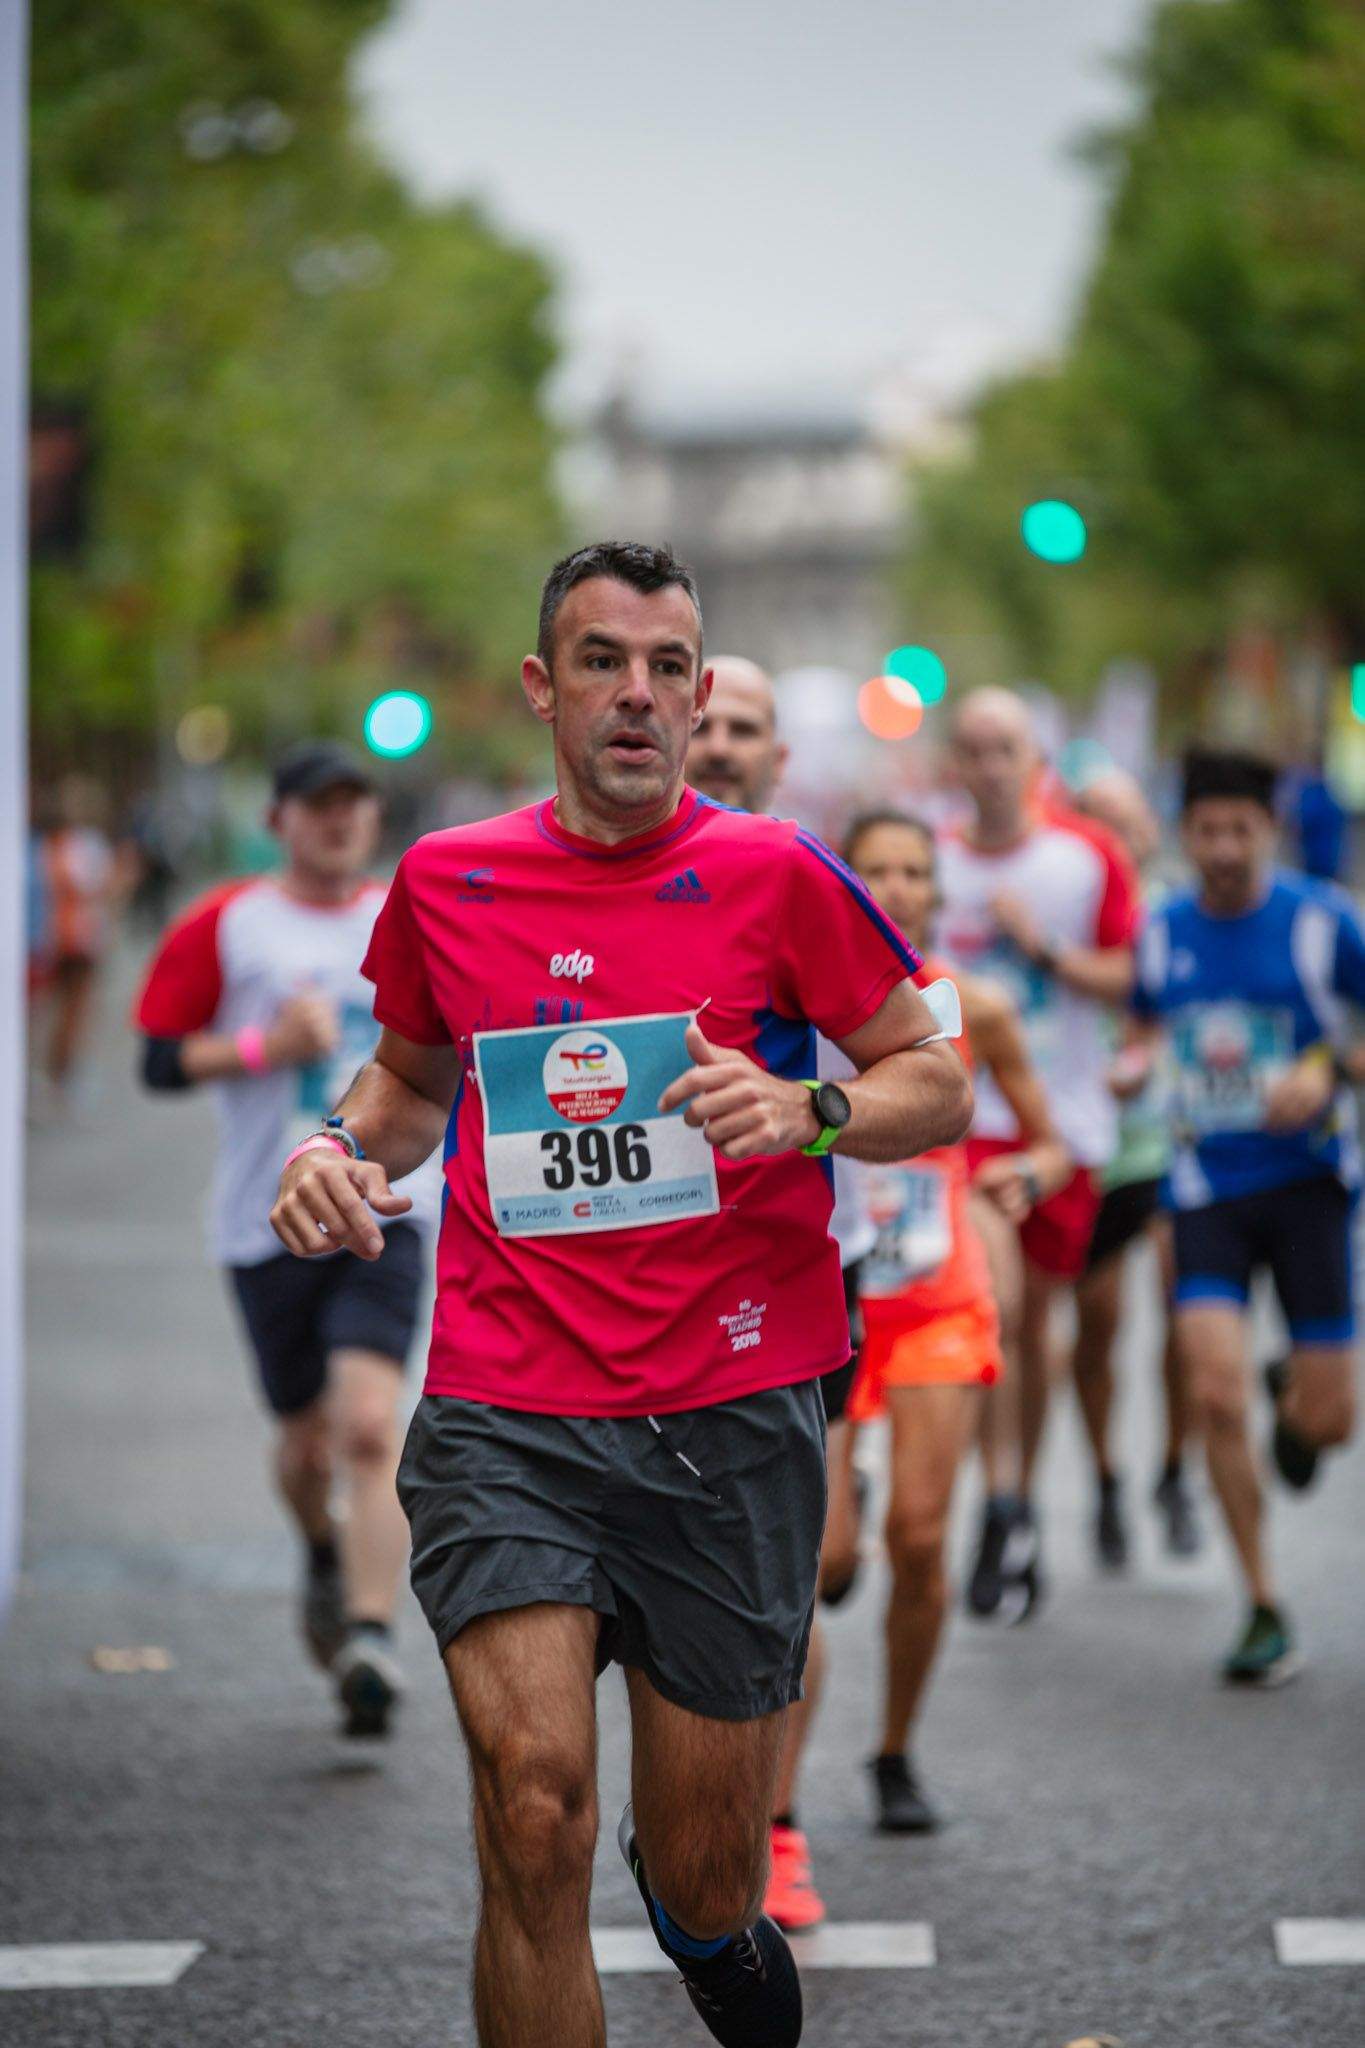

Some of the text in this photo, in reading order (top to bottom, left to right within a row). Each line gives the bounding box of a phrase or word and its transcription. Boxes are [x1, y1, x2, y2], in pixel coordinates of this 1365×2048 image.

[549, 948, 595, 984] edp
[541, 1124, 651, 1190] 396
[516, 1206, 562, 1219] MADRID
